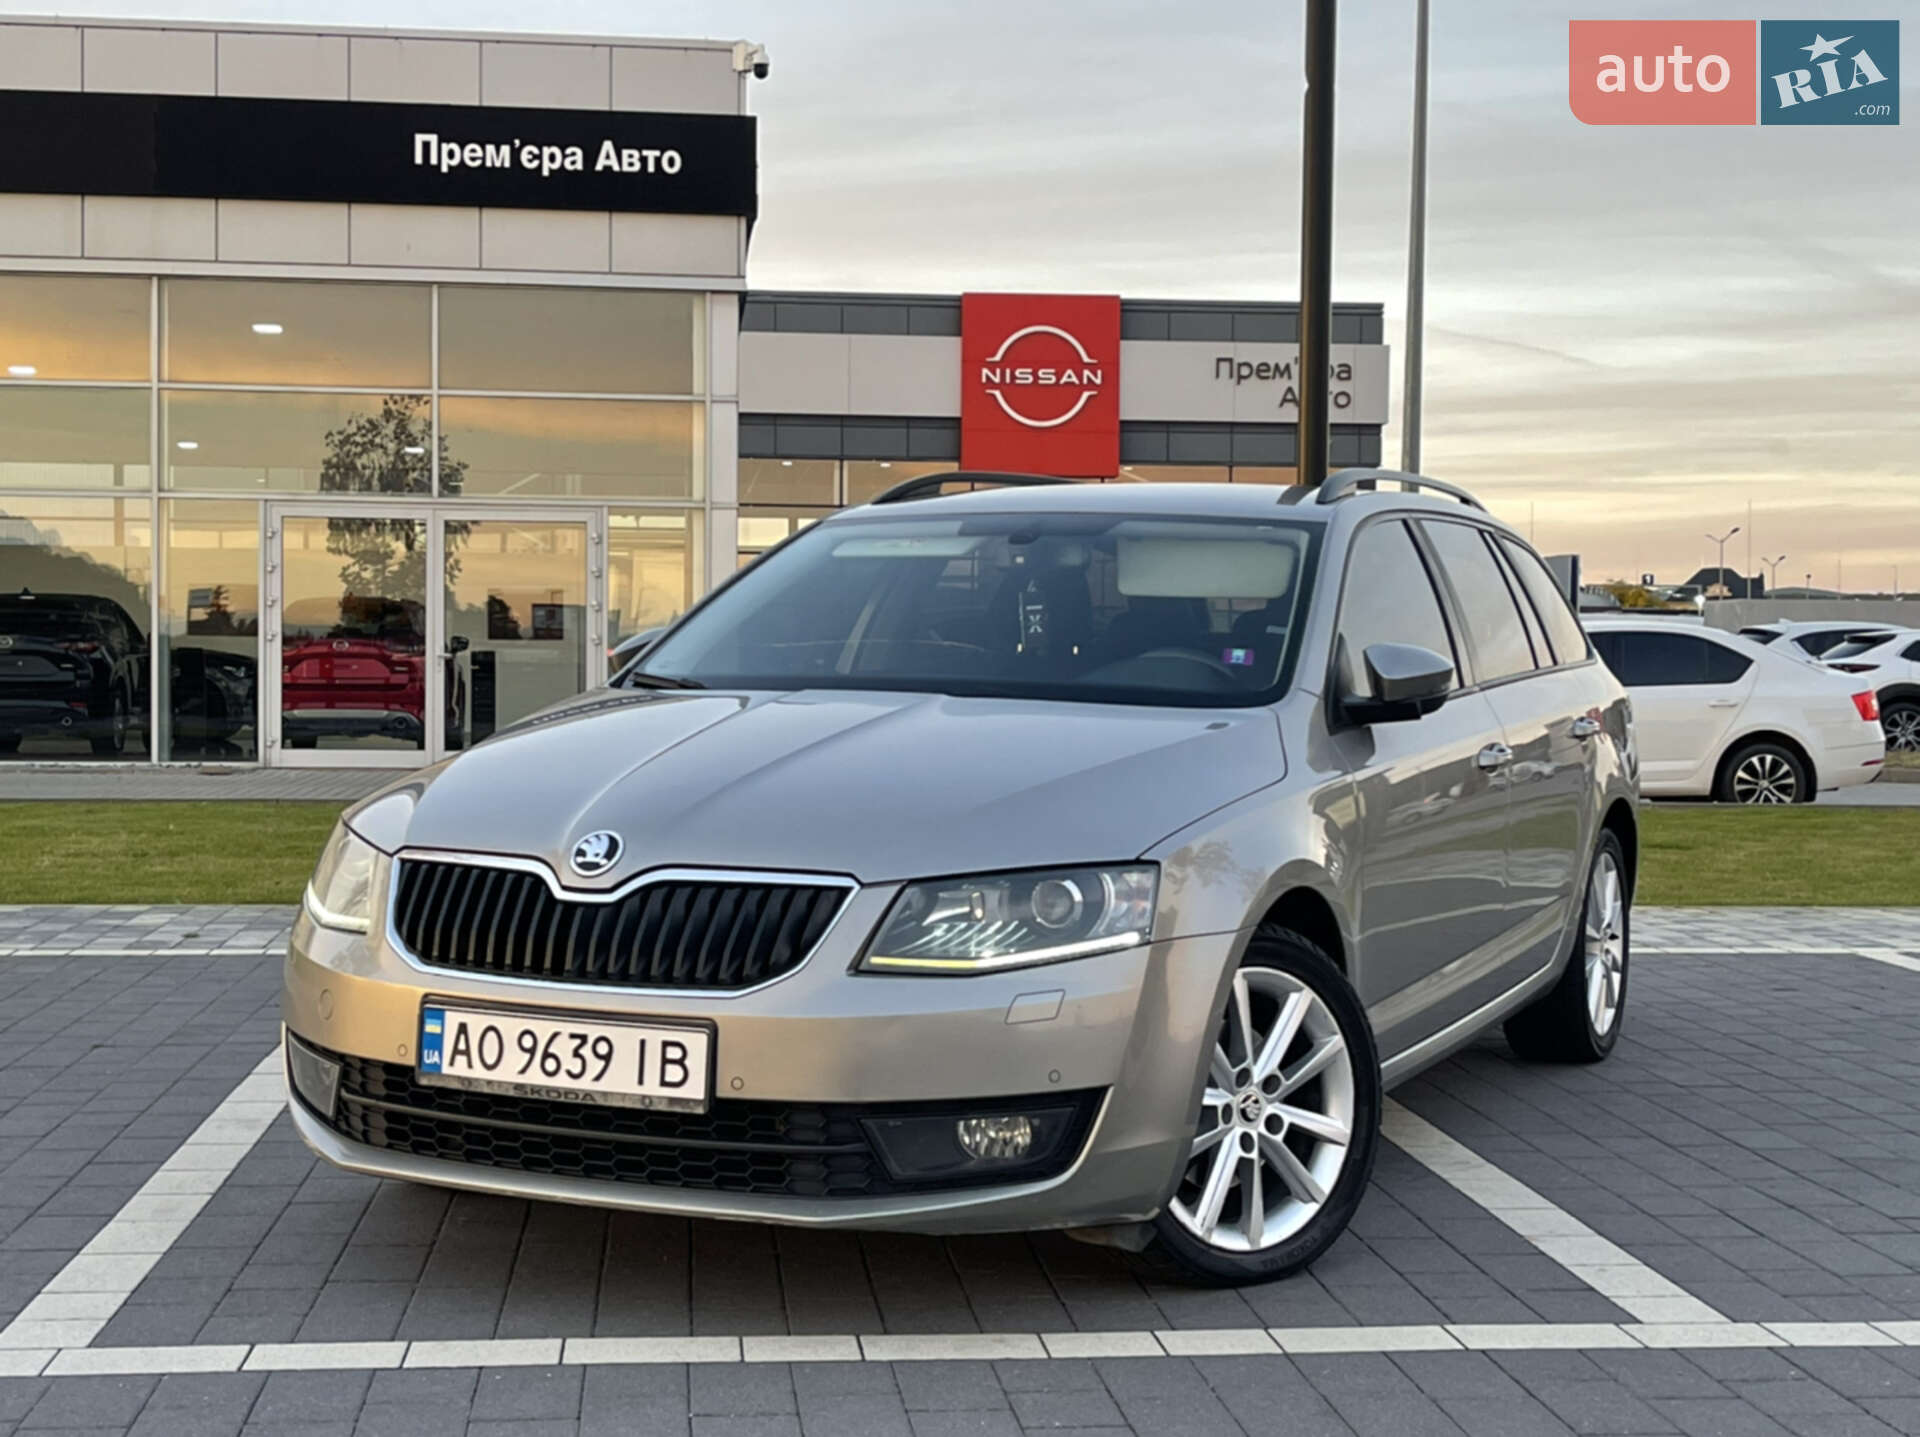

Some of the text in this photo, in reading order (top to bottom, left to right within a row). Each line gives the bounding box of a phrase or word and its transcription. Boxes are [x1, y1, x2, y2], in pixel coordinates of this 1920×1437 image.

[595, 140, 682, 174] Авто
[981, 367, 1102, 386] NISSAN
[1215, 356, 1353, 386] Прем'а
[1278, 386, 1352, 409] Ао
[423, 1049, 441, 1065] UA
[516, 1028, 615, 1082] 9639
